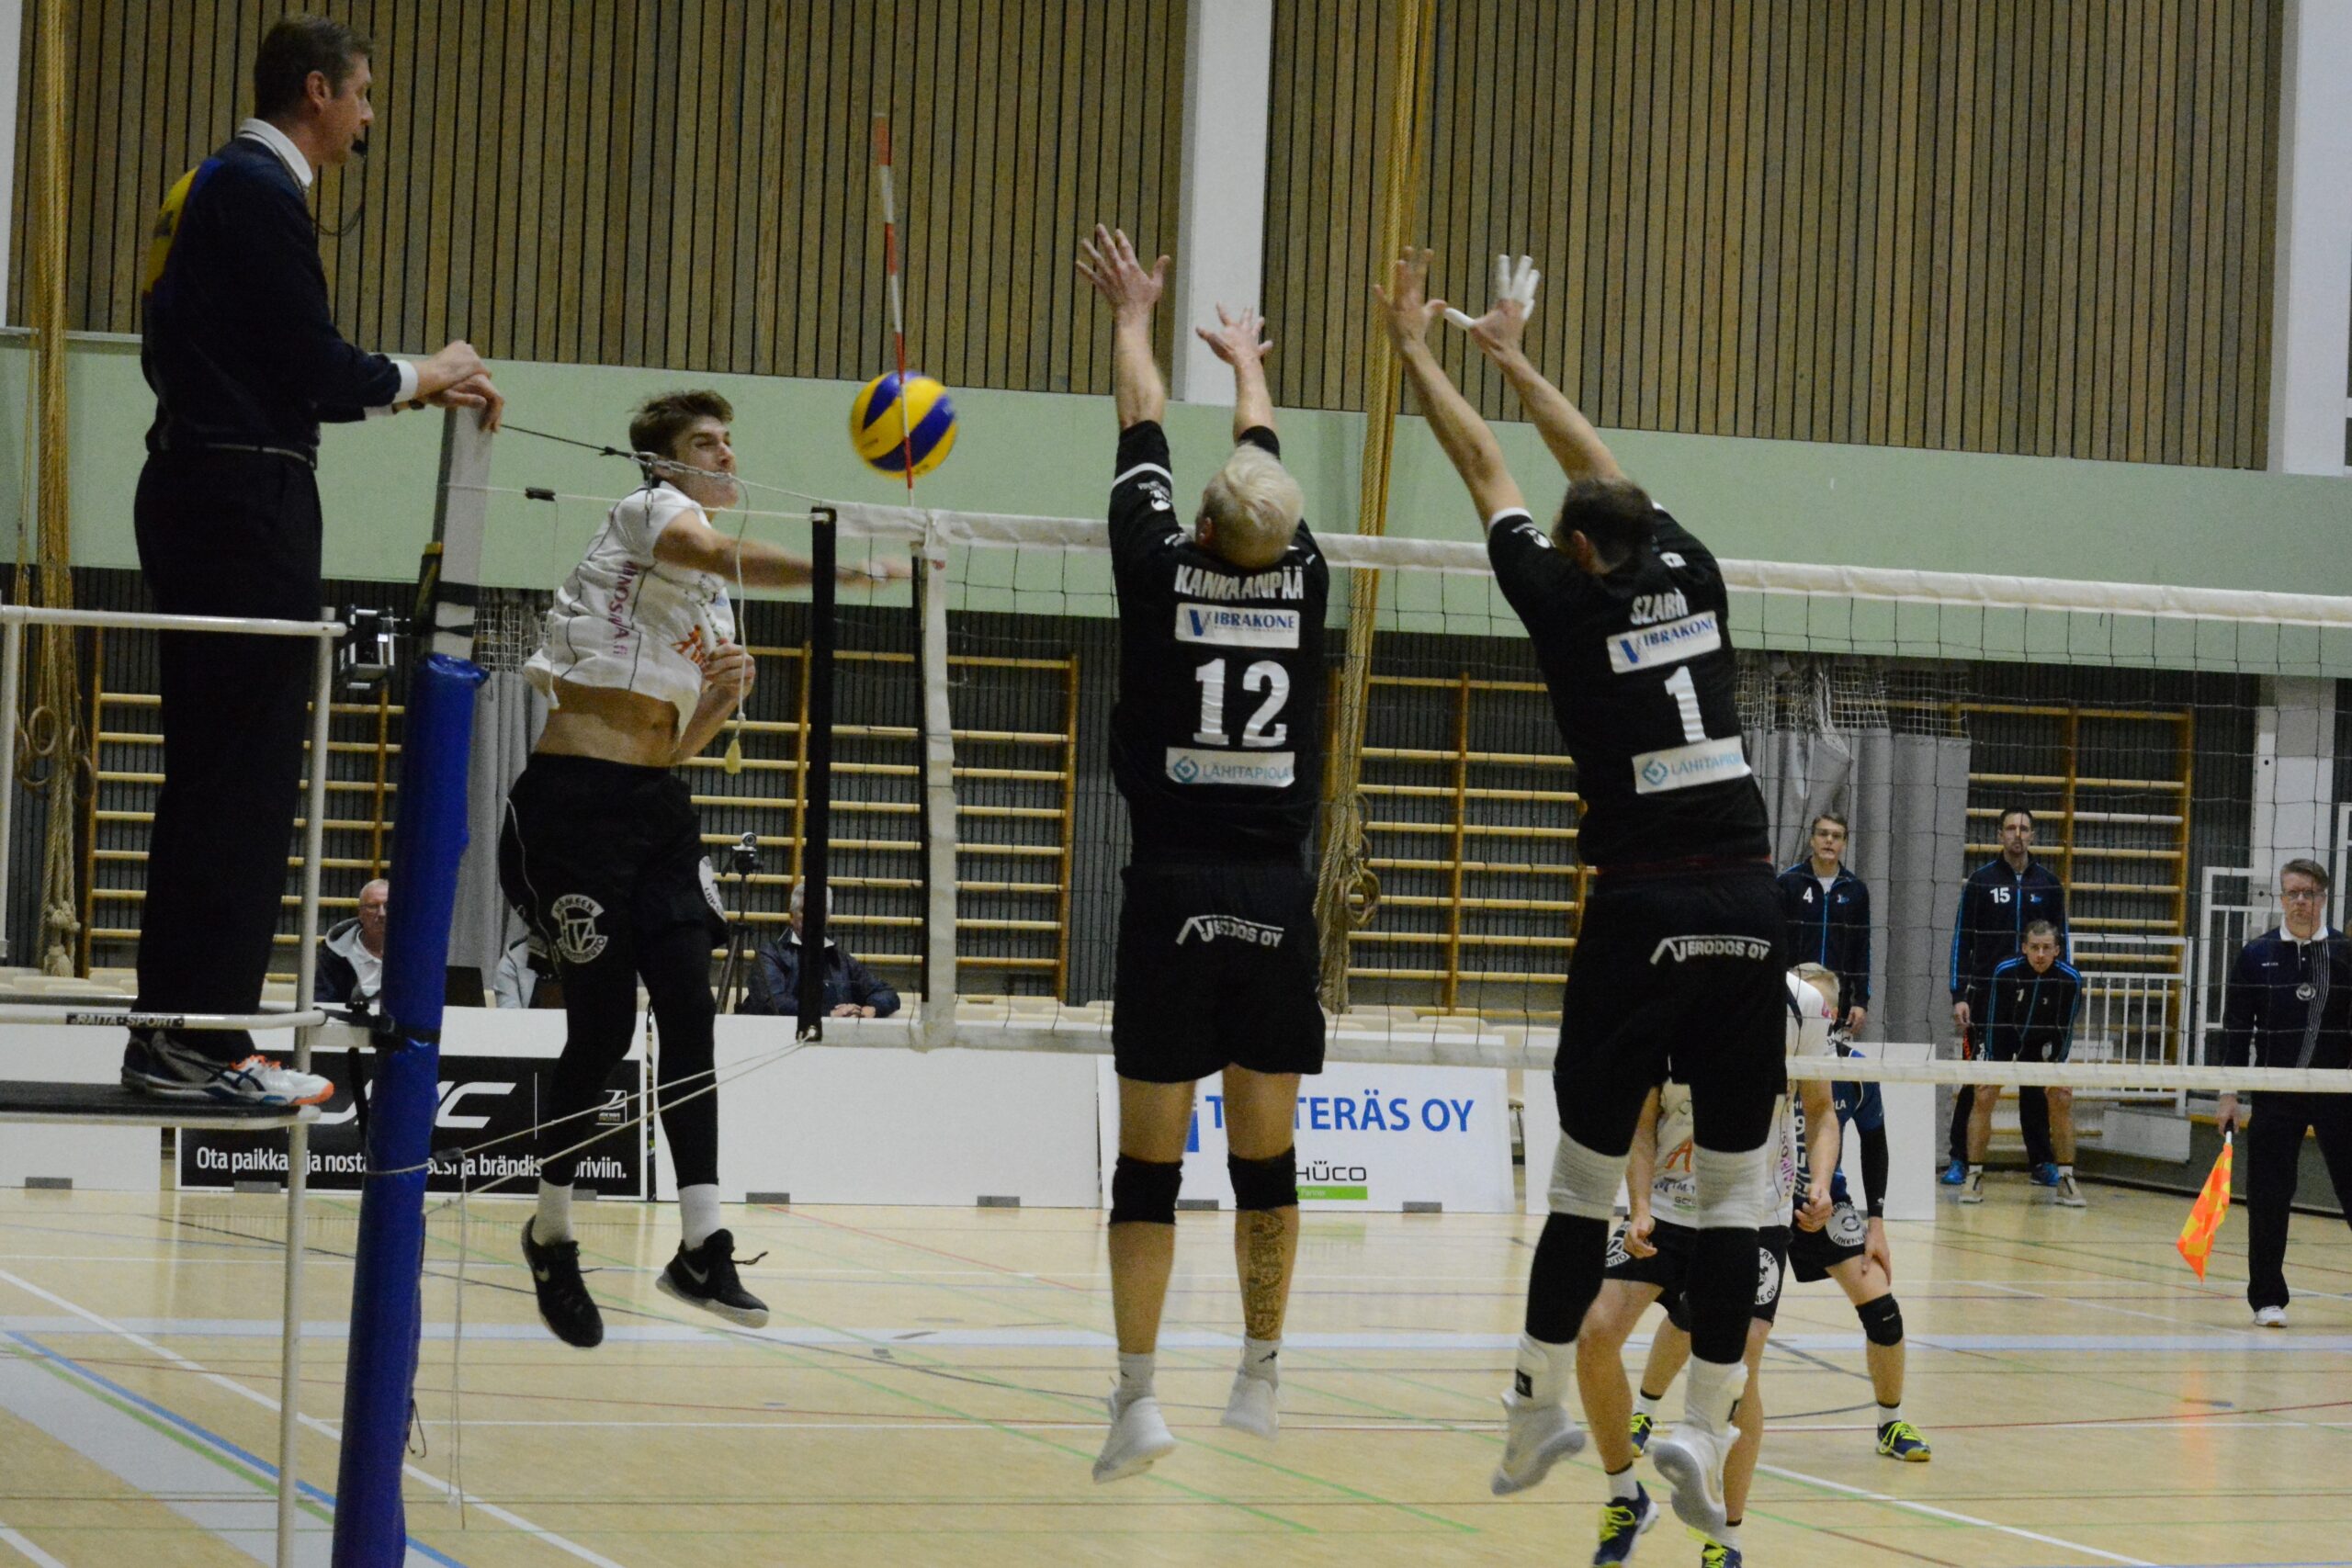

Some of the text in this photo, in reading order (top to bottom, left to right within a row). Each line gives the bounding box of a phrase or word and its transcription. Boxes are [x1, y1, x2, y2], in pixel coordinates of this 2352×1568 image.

[1174, 564, 1304, 599] KANKAANPÄÄ
[1193, 658, 1290, 747] 12
[1664, 666, 1713, 744] 1
[1803, 886, 1814, 904] 4
[1990, 887, 2010, 904] 15
[1260, 931, 1283, 948] OY
[1747, 942, 1770, 961] OY
[1421, 1098, 1475, 1133] OY
[197, 1146, 228, 1169] Ota
